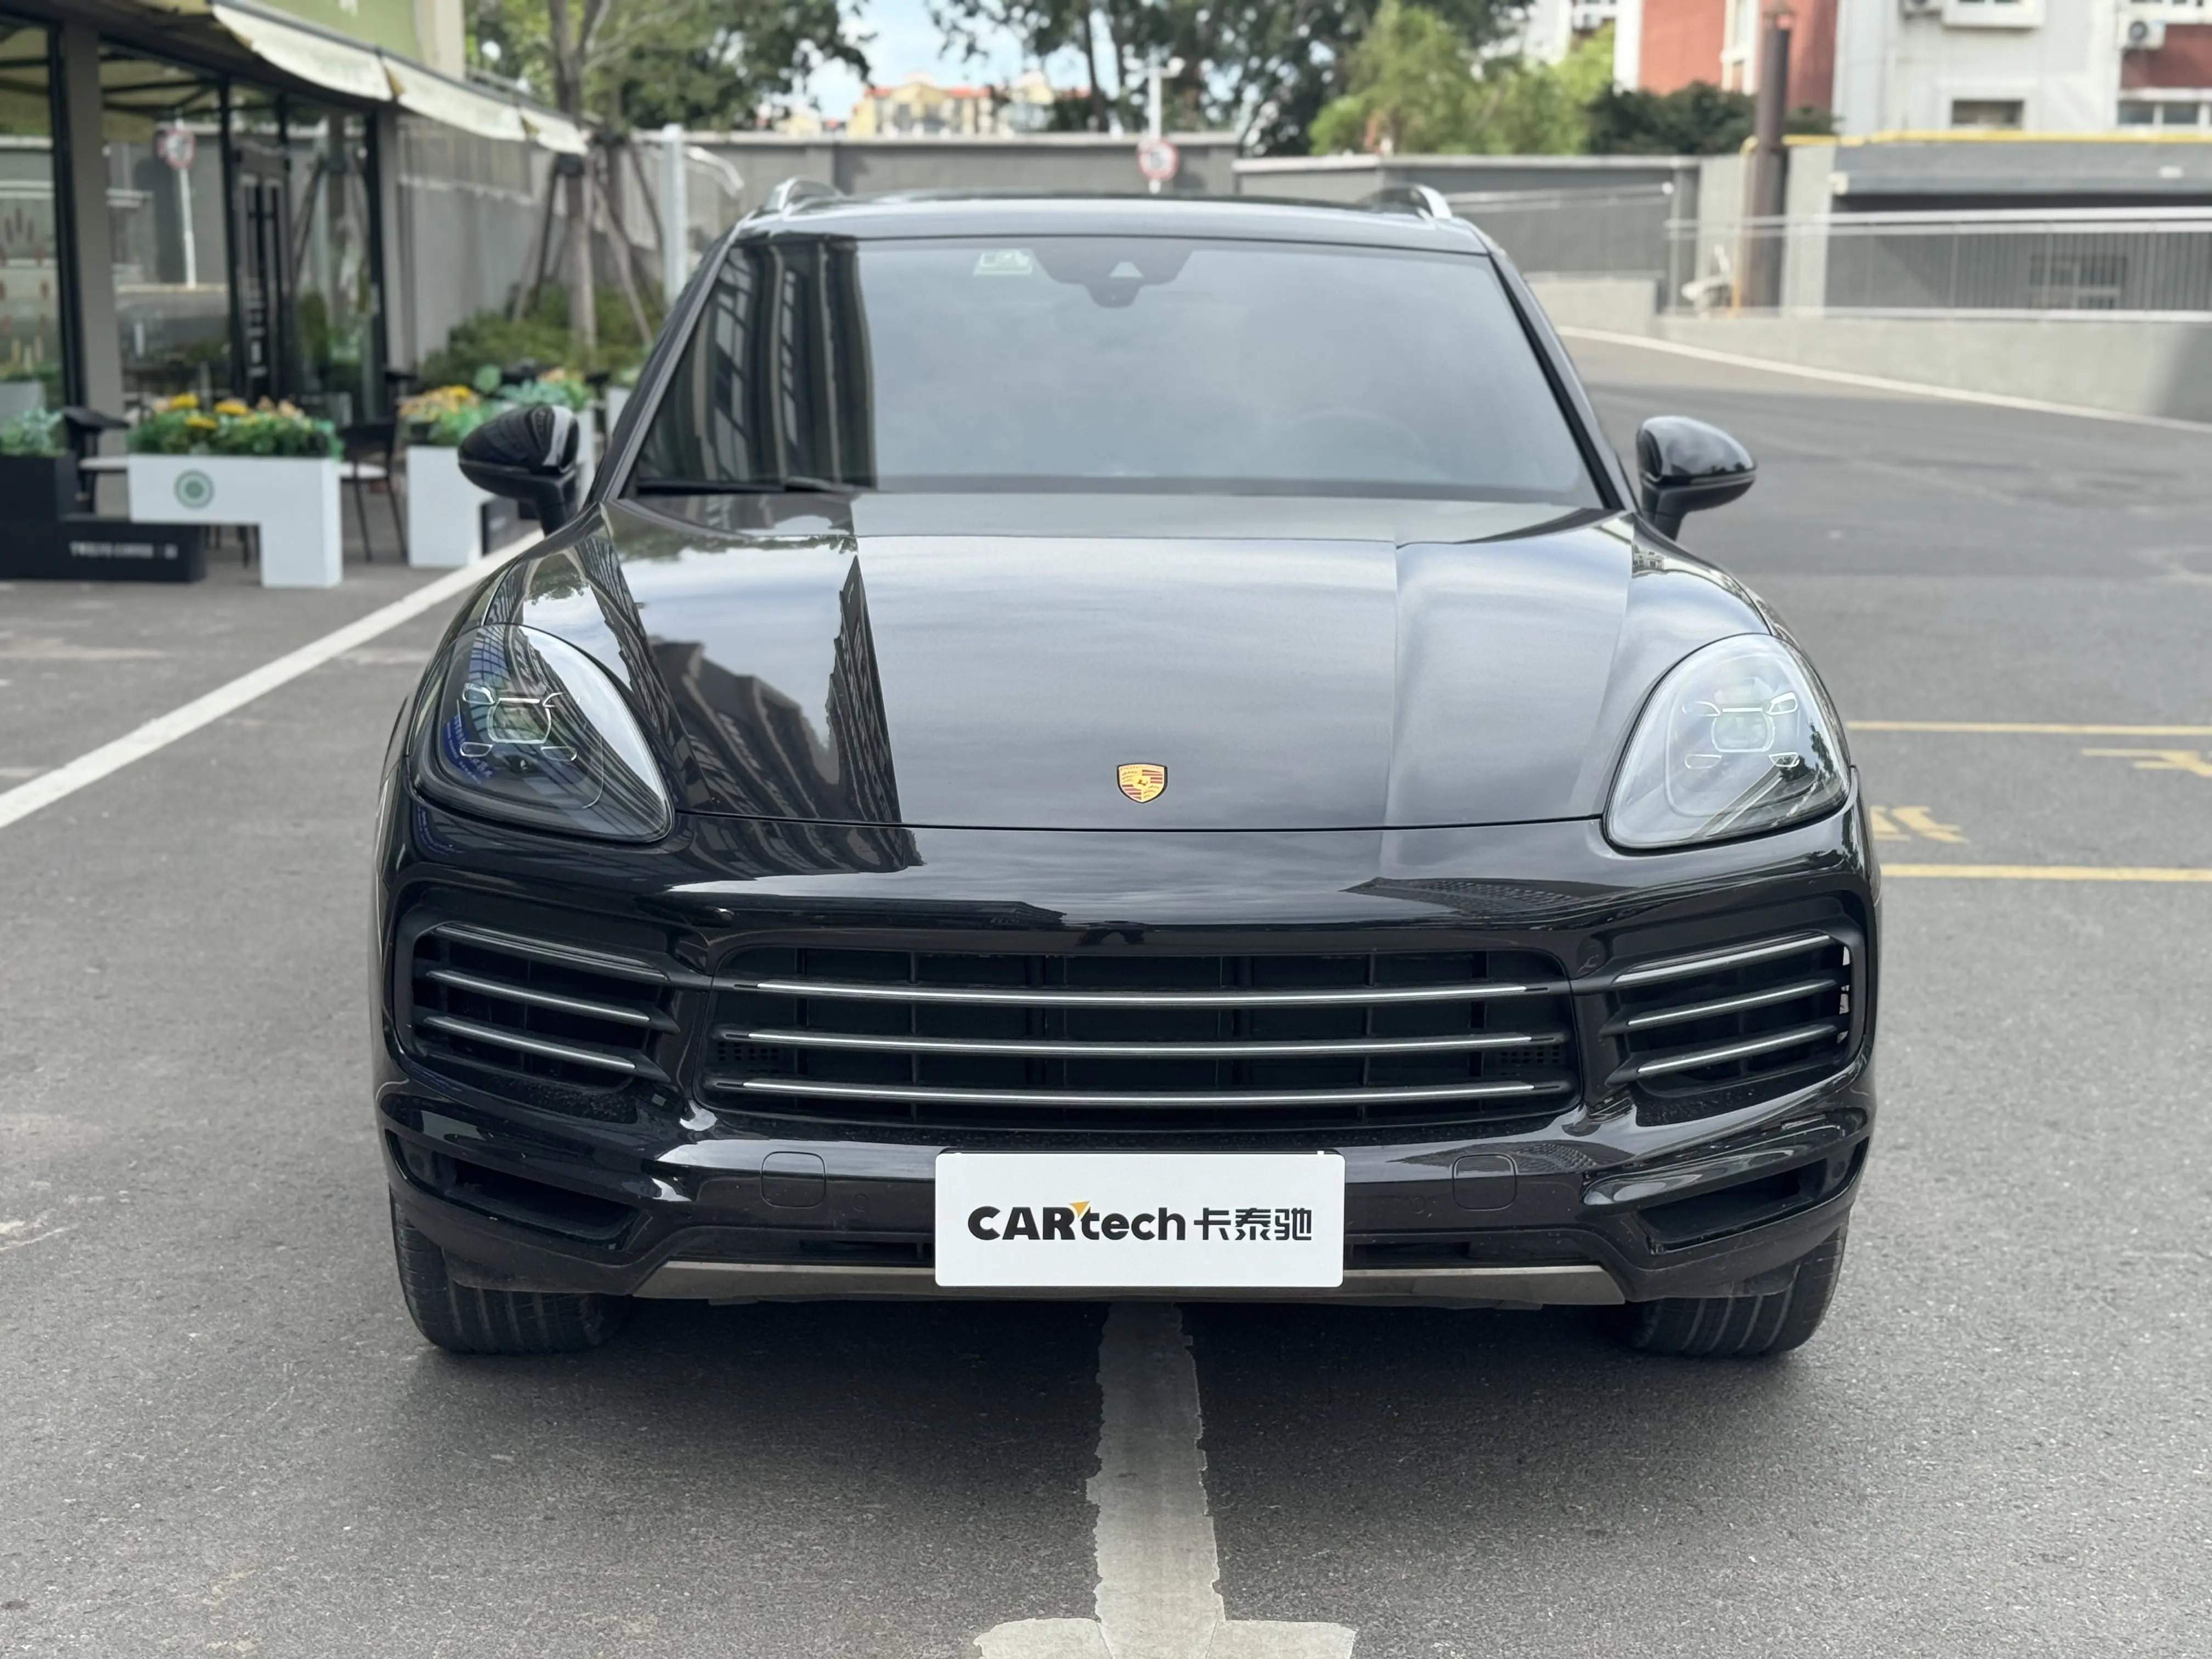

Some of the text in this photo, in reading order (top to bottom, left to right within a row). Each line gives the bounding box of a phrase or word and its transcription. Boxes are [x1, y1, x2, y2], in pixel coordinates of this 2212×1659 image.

[968, 1201, 1312, 1241] CARtech 卡泰驰
